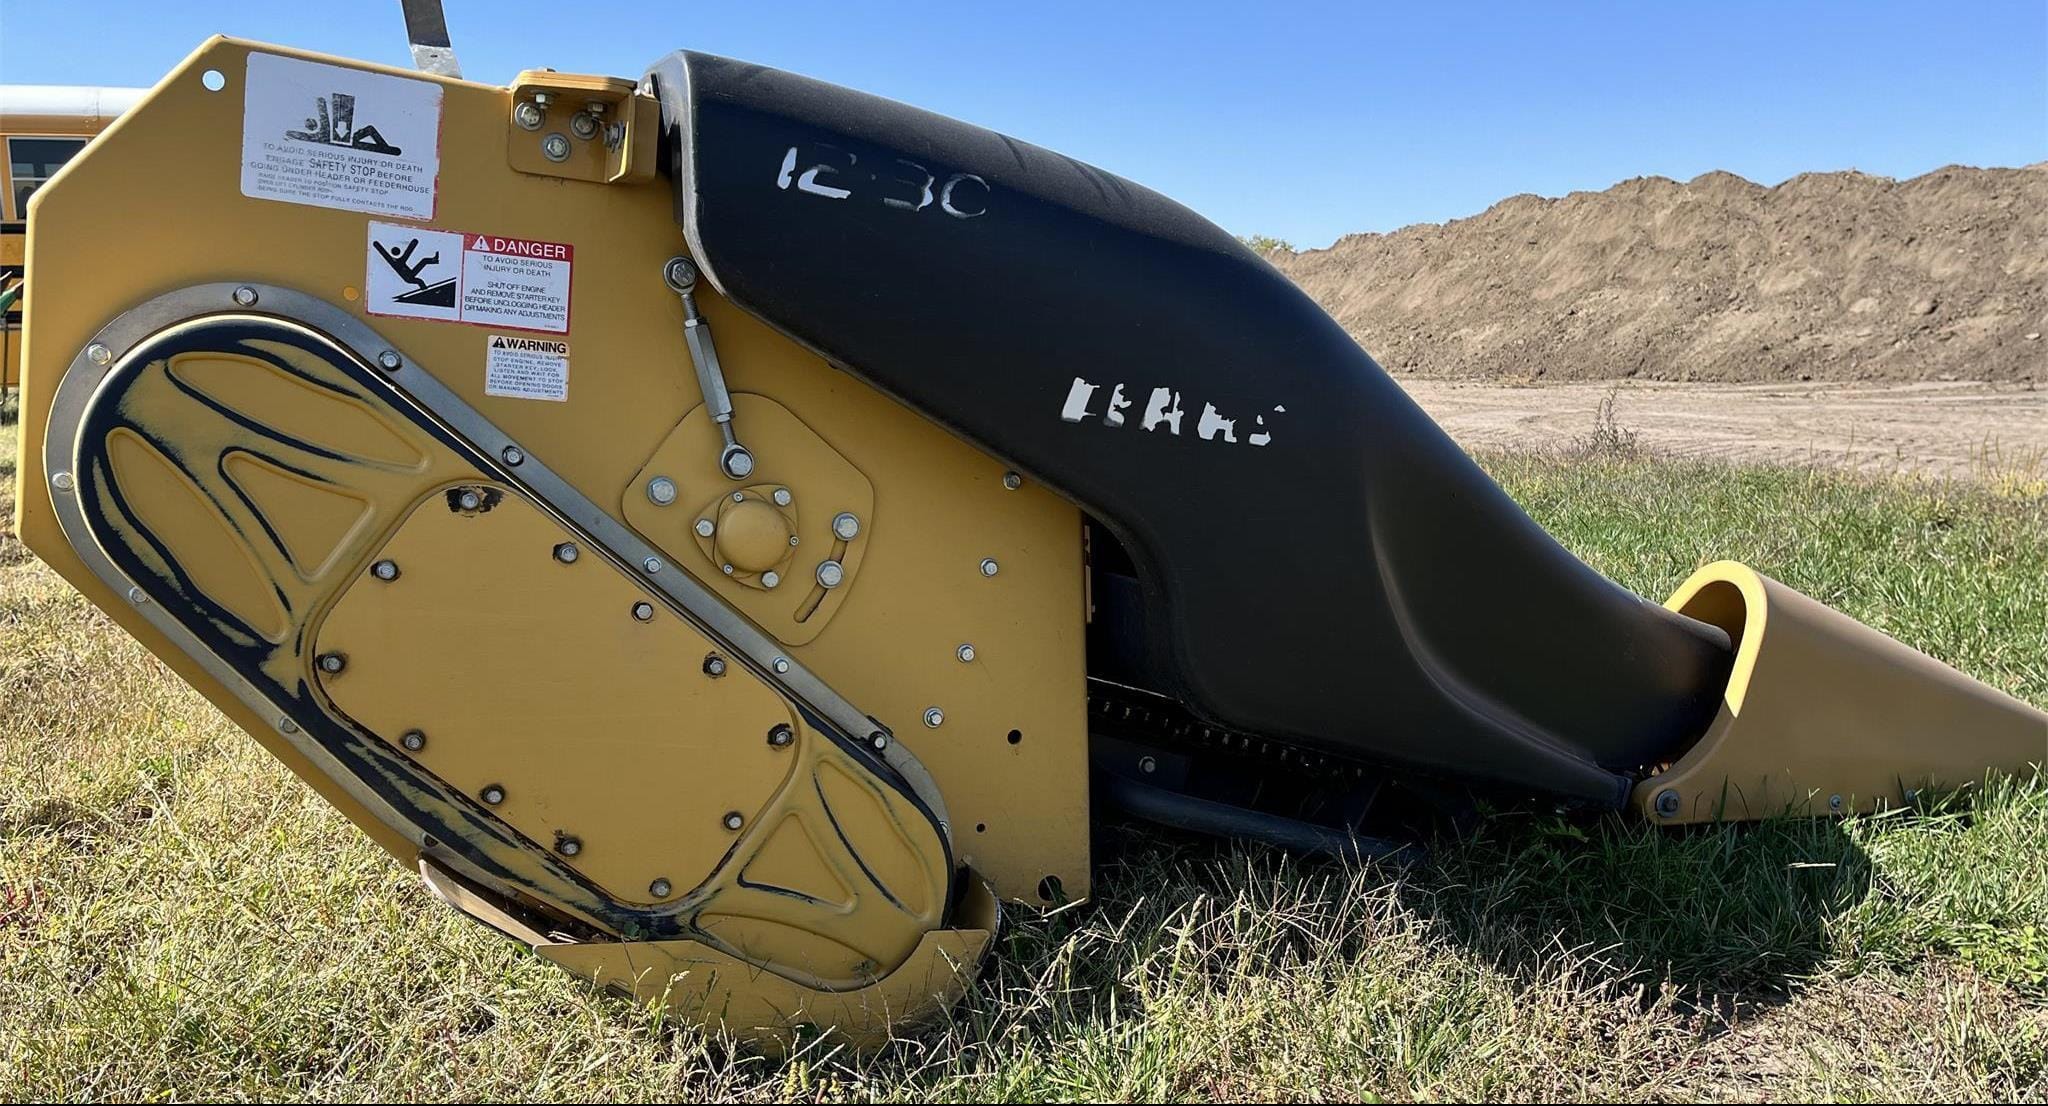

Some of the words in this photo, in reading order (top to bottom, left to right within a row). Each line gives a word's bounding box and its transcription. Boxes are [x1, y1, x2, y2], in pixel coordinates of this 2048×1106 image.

[277, 146, 304, 155] AVOID
[307, 149, 345, 160] SERIOUS
[348, 156, 378, 166] INJURY
[396, 164, 423, 173] DEATH
[266, 155, 304, 166] ENGAGE
[309, 158, 346, 172] SAFETY
[351, 165, 376, 176] STOP
[378, 171, 412, 182] BEFORE
[250, 161, 278, 172] GOING
[282, 165, 312, 176] UNDER
[315, 170, 350, 181] HEADER
[369, 179, 429, 194] FEEDERHOUSE
[314, 181, 342, 189] POSITION
[344, 184, 368, 192] SAFETY
[352, 198, 385, 208] CONTACTS
[494, 238, 566, 259] DANGER
[484, 264, 511, 272] INJURY
[495, 257, 518, 266] AVOID
[520, 260, 553, 269] SERIOUS
[487, 290, 515, 299] REMOVE
[516, 293, 546, 302] STARTER
[522, 285, 546, 294] ENGINE
[465, 296, 492, 304] BEFORE
[494, 298, 538, 310] UNCLOGGING
[475, 305, 503, 314] MAKING
[518, 310, 565, 321] ADJUSTMENTS
[507, 338, 566, 354] WARNING
